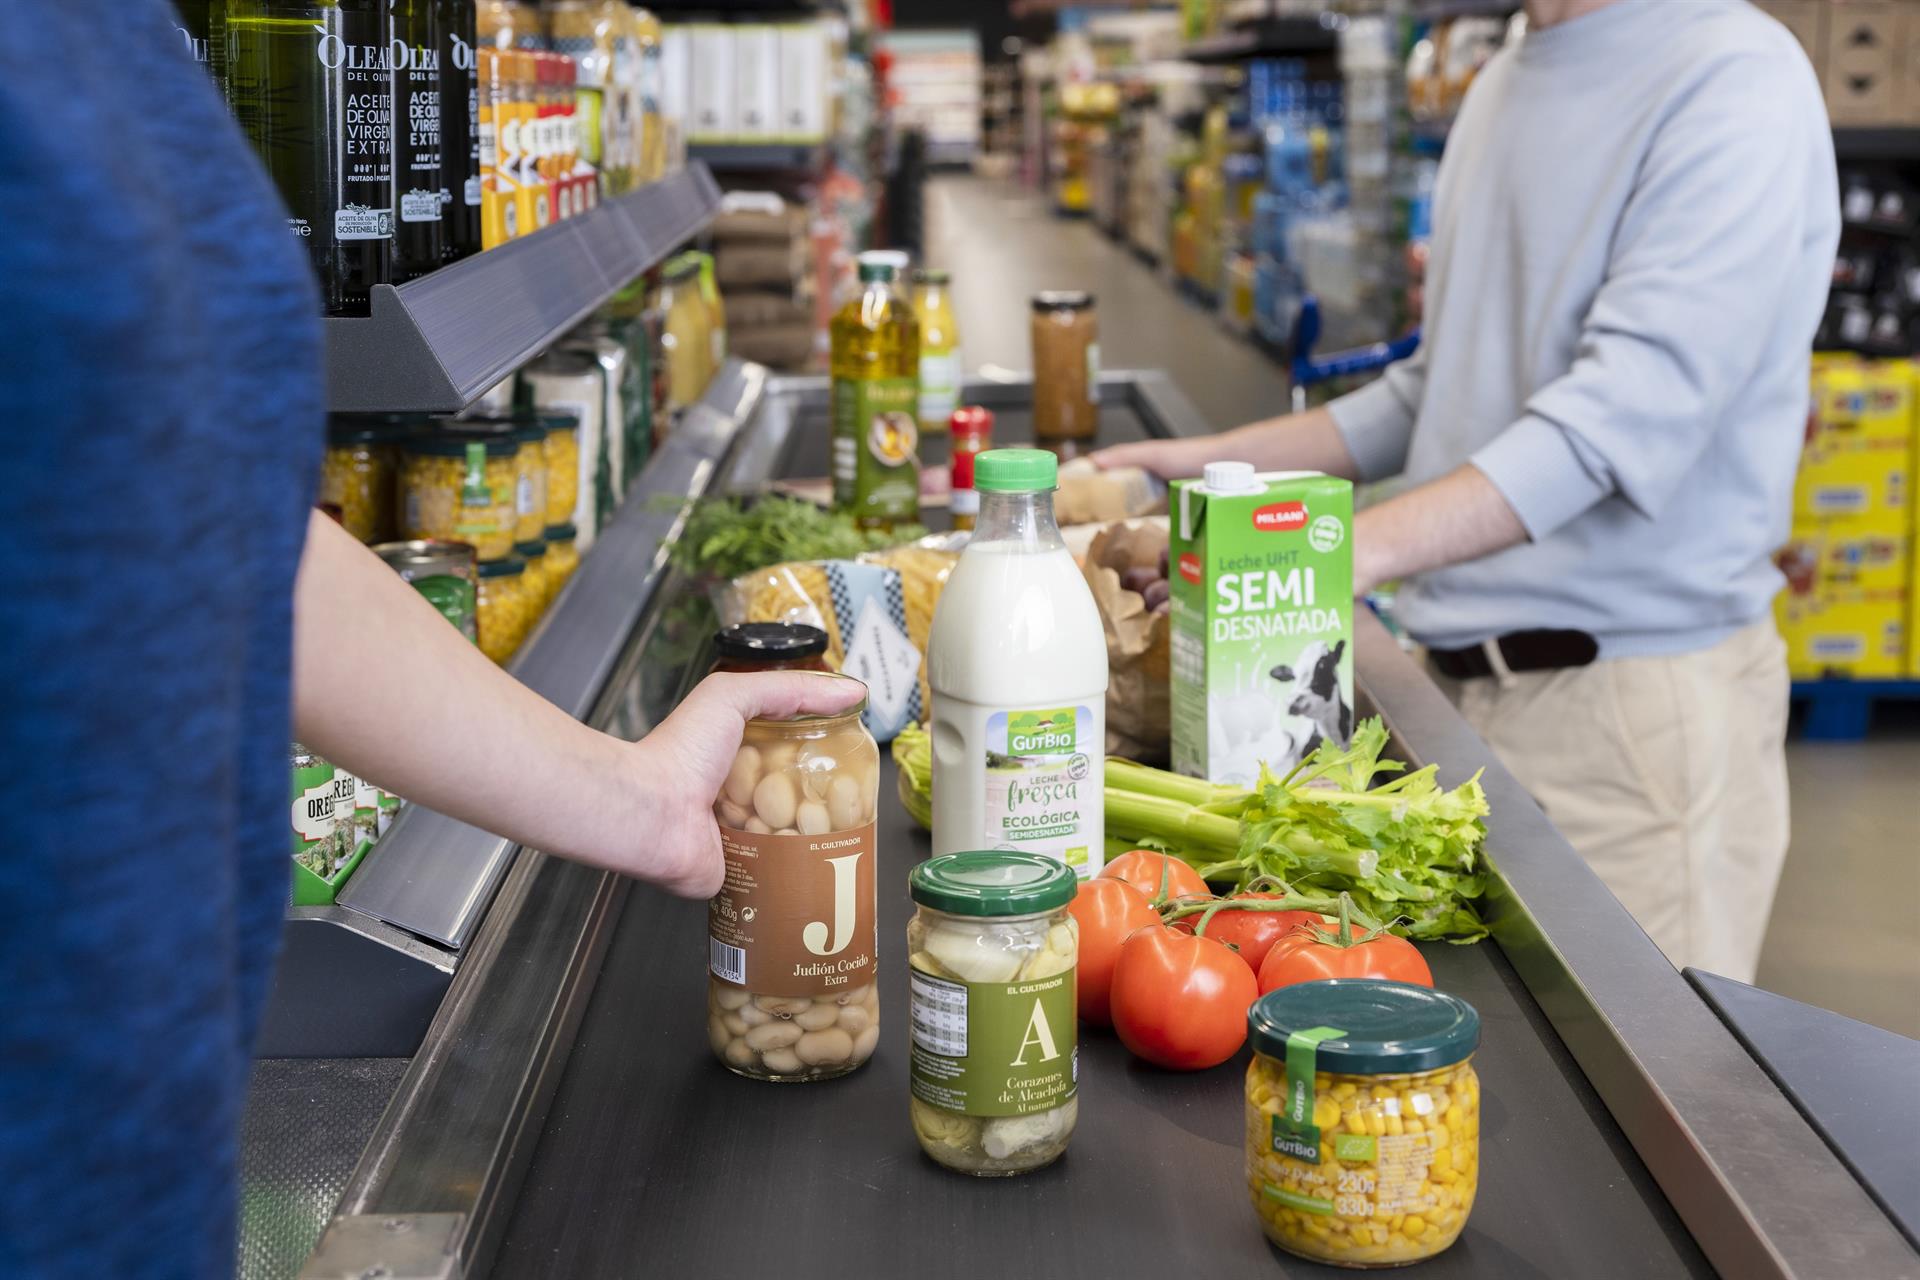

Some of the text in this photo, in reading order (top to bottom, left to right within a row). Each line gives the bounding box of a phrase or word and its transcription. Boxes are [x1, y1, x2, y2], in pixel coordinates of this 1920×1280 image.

[347, 72, 368, 81] DEL
[347, 94, 390, 108] ACEITE
[347, 109, 365, 123] DE
[347, 125, 391, 139] VIRGEN
[347, 141, 391, 155] EXTRA
[337, 226, 377, 234] SOSTENIBLE
[1218, 554, 1261, 571] Leche
[1267, 549, 1300, 566] UHT
[1215, 566, 1315, 615] SEMI
[1214, 607, 1342, 643] DESNATADA
[1030, 774, 1059, 785] LECHE
[1007, 779, 1078, 812] fresca
[1002, 810, 1081, 829] ECOLÓGICA
[1008, 825, 1075, 841] SEMIDESNATADA
[810, 837, 861, 851] EL CULTIVADOR
[803, 852, 864, 956] J
[793, 954, 869, 976] Judión Cocido
[824, 974, 848, 986] Extra
[1007, 978, 1063, 995] EL CULTIVADOR
[1009, 997, 1061, 1067] A
[1006, 1072, 1062, 1090] Corazones
[998, 1080, 1067, 1104] de Alcachofa
[1016, 1097, 1056, 1113] Al natural
[1337, 1171, 1374, 1194] 230g
[1337, 1194, 1374, 1217] 330g
